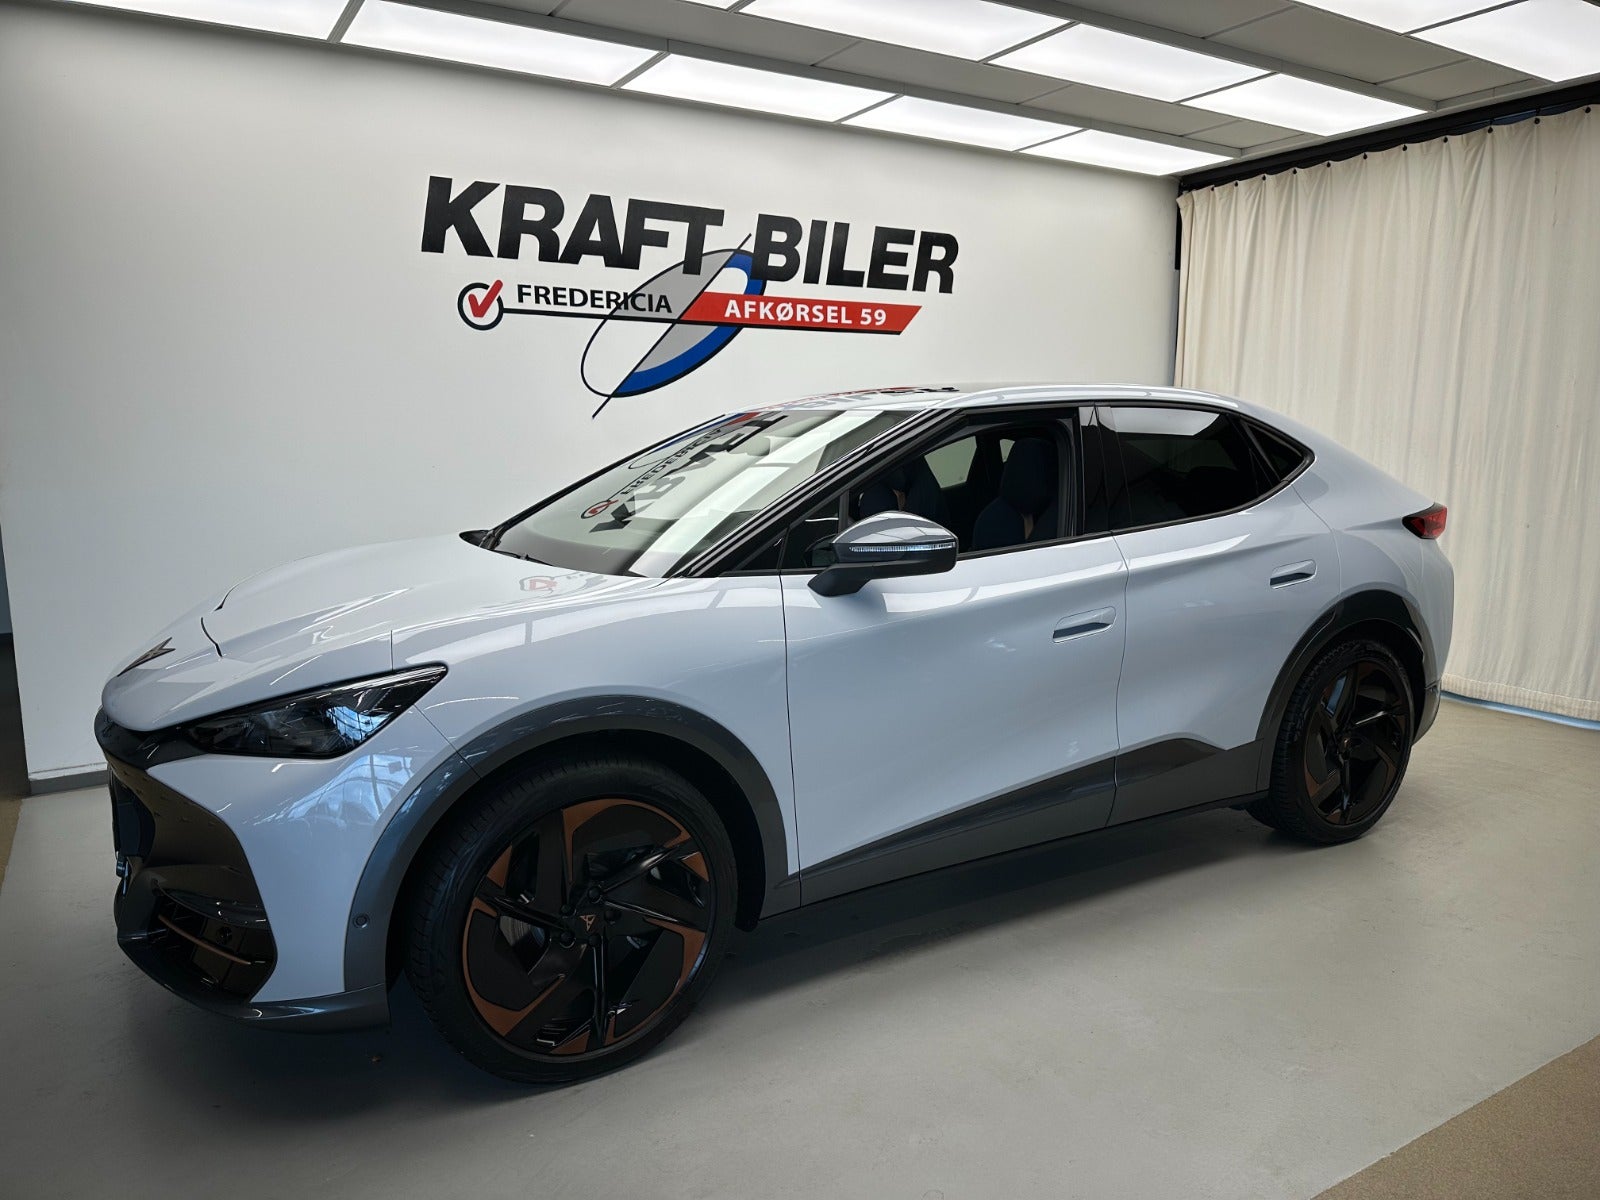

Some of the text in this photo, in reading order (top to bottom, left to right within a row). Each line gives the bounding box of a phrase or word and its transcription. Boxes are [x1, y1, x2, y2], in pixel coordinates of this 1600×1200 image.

[421, 176, 960, 294] KRAFT BILER
[517, 284, 672, 314] FREDERICIA
[724, 299, 887, 326] AFKØRSEL 59
